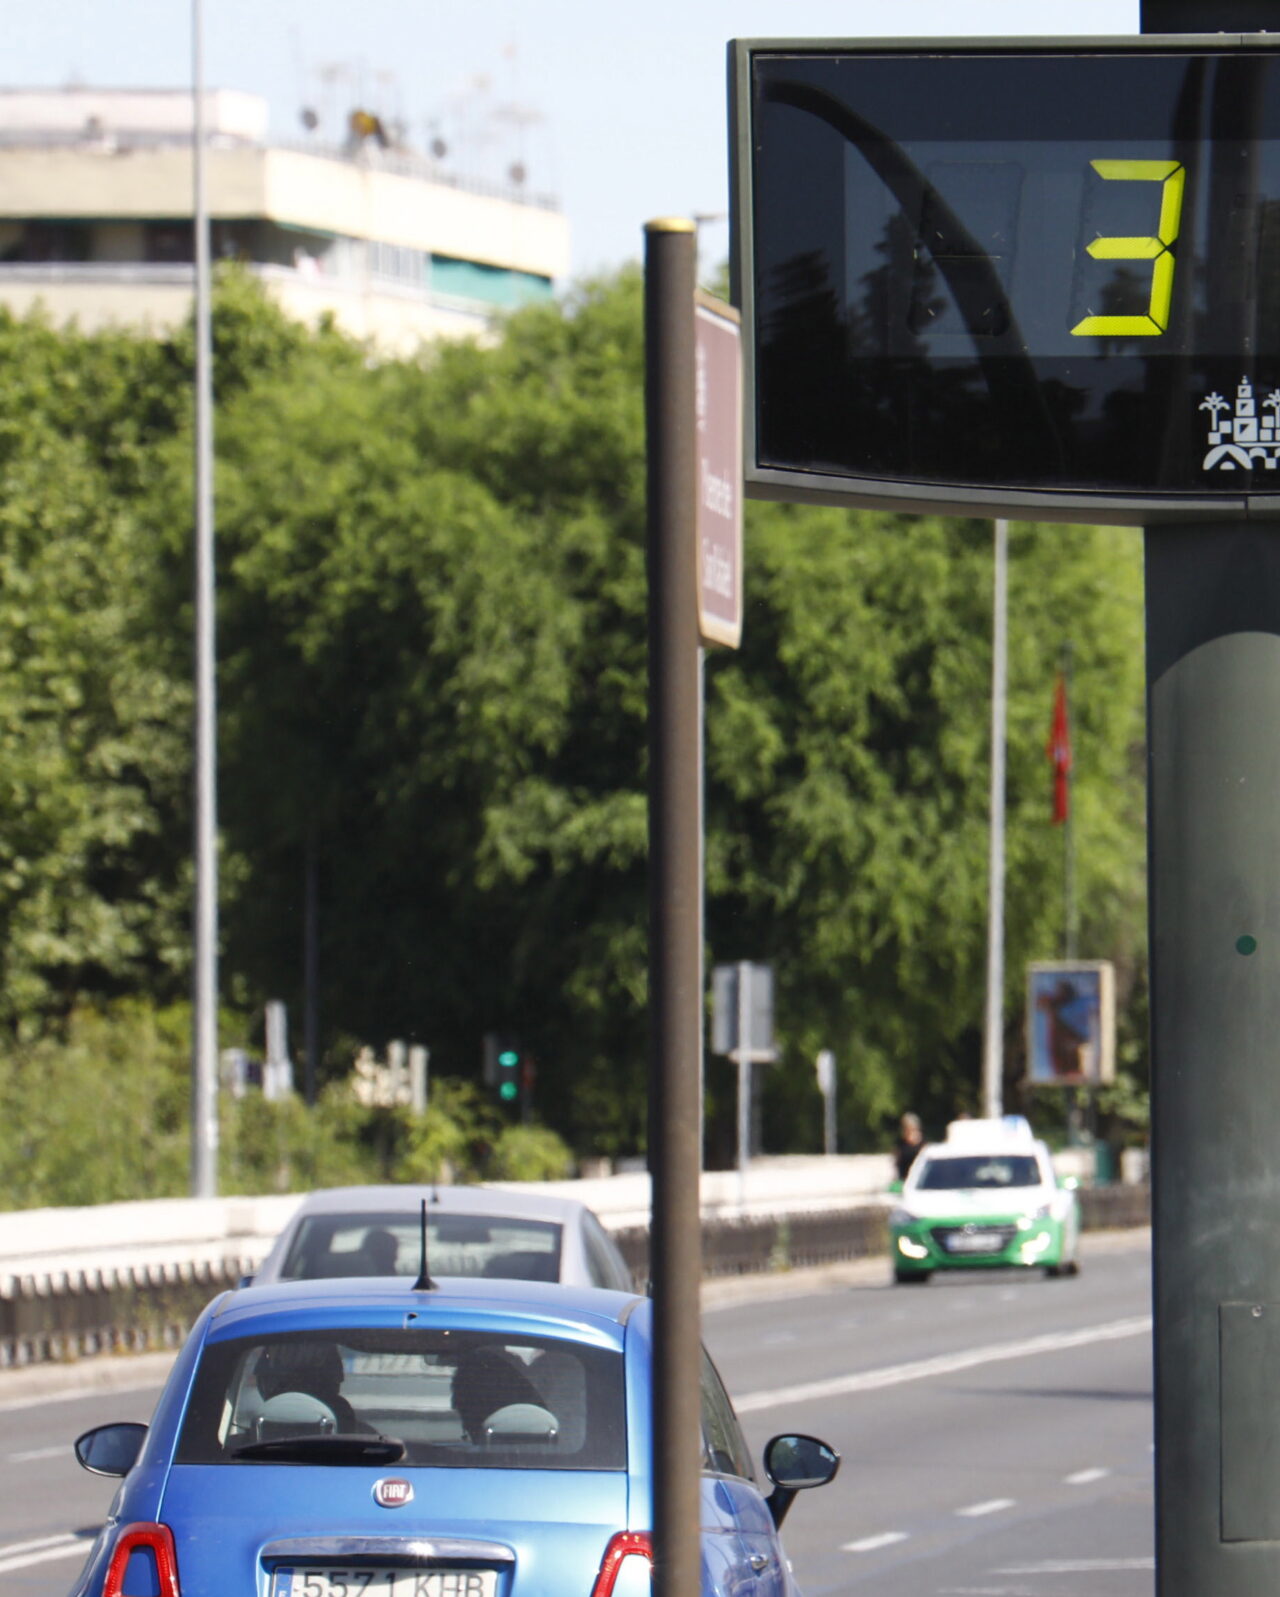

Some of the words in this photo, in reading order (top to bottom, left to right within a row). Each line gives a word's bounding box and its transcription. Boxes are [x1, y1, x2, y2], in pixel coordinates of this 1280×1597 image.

[383, 1484, 406, 1498] FIAT
[303, 1571, 397, 1597] 5571
[414, 1572, 483, 1597] KHB
